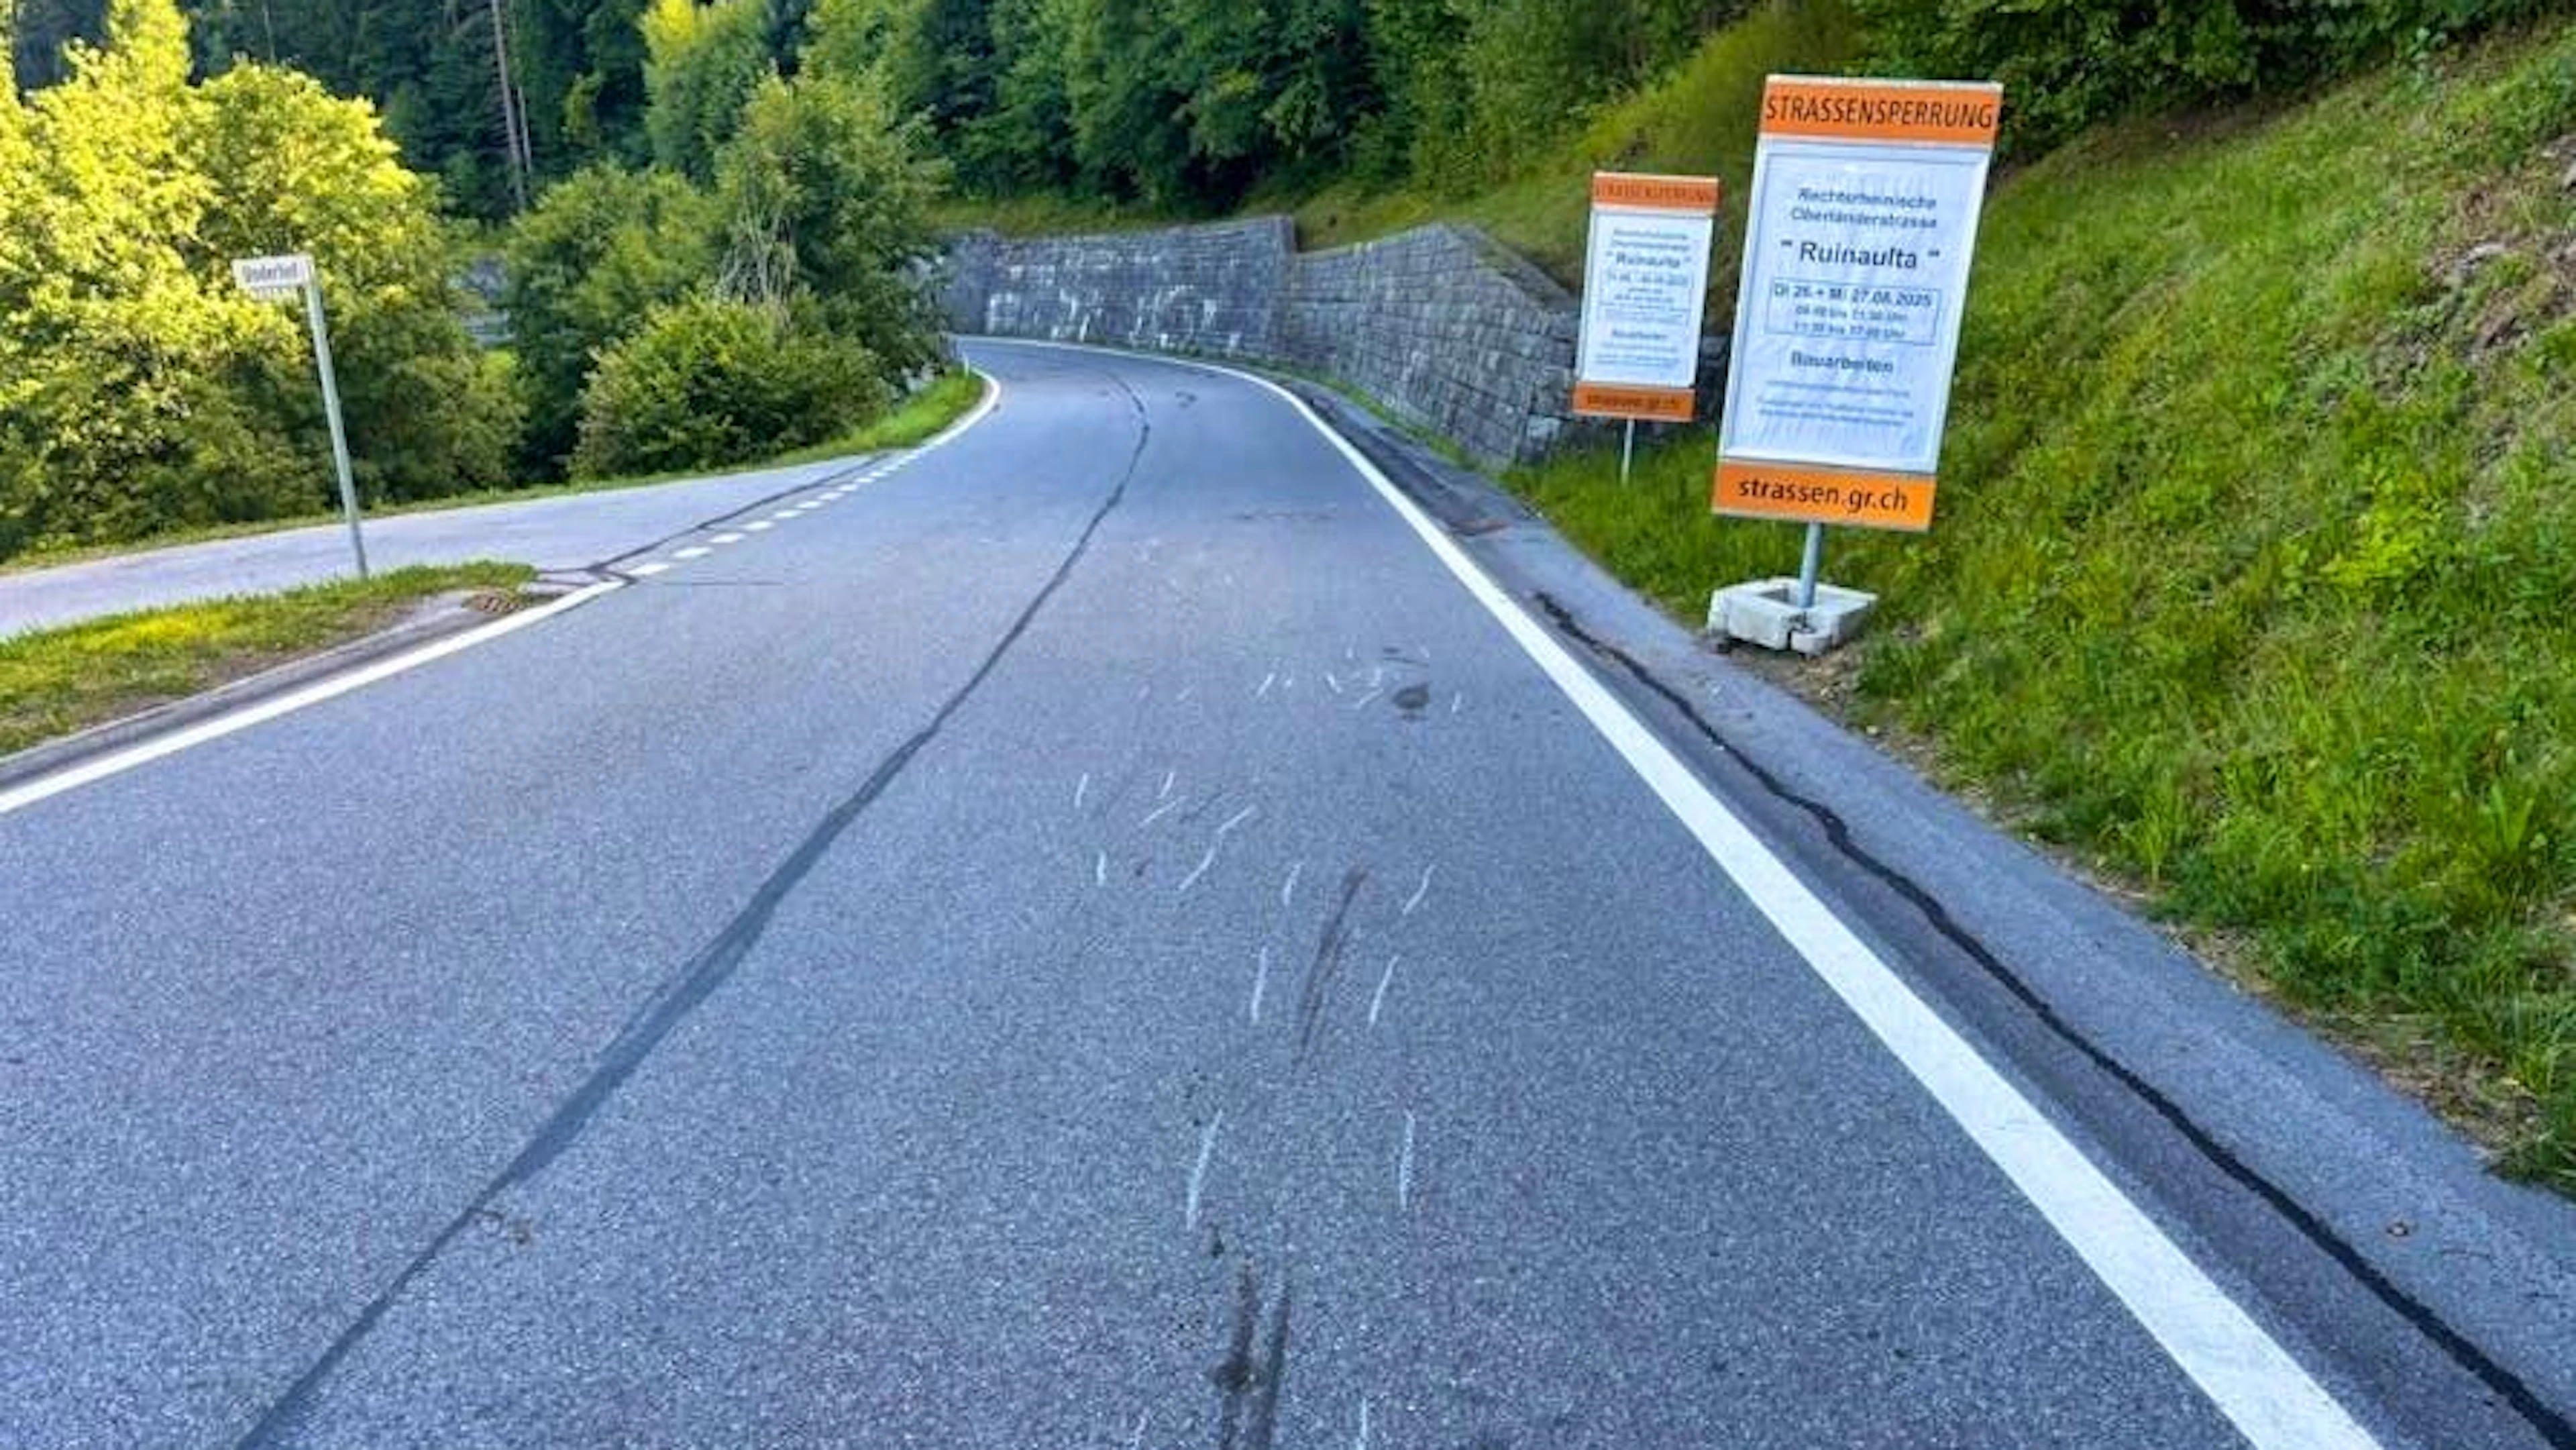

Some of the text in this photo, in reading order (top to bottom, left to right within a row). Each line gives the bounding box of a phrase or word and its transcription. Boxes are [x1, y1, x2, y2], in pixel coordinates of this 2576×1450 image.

[1766, 94, 1992, 128] STRASSENSPERRUNG
[1800, 240, 1917, 269] Ruinaulta
[1791, 350, 1894, 372] Bauarbeiten
[1739, 477, 1908, 514] strassen.gr.ch
